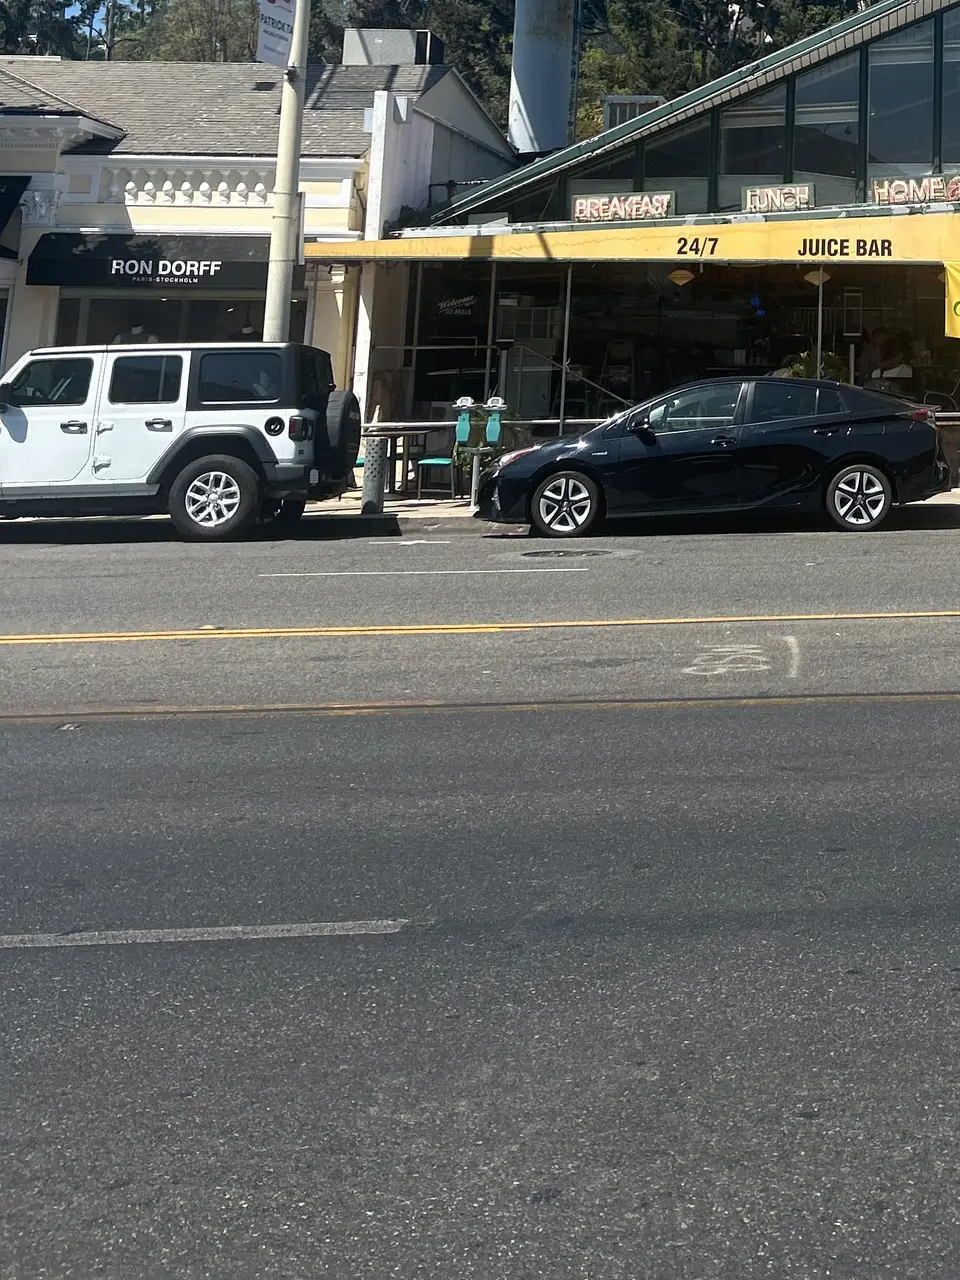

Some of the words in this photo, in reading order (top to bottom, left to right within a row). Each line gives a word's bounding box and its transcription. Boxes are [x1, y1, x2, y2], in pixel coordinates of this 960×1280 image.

[745, 186, 814, 212] LUNCH
[873, 177, 945, 206] HOME
[574, 194, 672, 221] BREAKFAST
[676, 237, 719, 257] 24/7
[797, 239, 850, 257] JUICE
[856, 239, 893, 257] BAR
[111, 260, 152, 274] RON
[158, 260, 222, 276] DORFF
